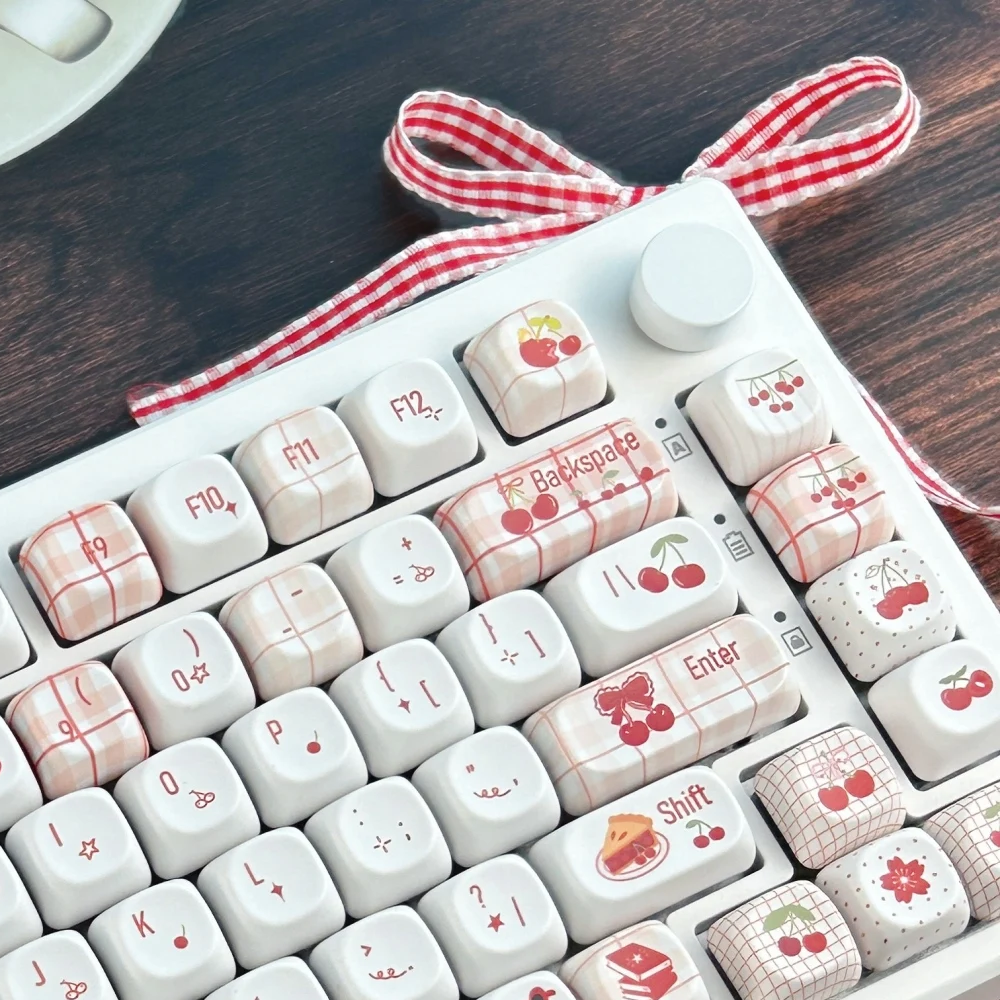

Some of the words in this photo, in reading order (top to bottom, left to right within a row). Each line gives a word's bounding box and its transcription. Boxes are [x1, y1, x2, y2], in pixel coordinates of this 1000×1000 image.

[390, 390, 425, 421] F12
[282, 439, 320, 470] F11
[530, 431, 640, 493] Backspace
[185, 486, 225, 519] F10
[80, 537, 107, 564] F9
[684, 639, 741, 680] Enter
[172, 670, 190, 691] 0
[58, 721, 76, 742] 9
[266, 720, 282, 744] P
[160, 772, 179, 795] O
[657, 784, 713, 824] Shift
[244, 863, 264, 885] L
[470, 885, 486, 908] ?
[132, 911, 154, 937] K
[32, 961, 46, 986] J
